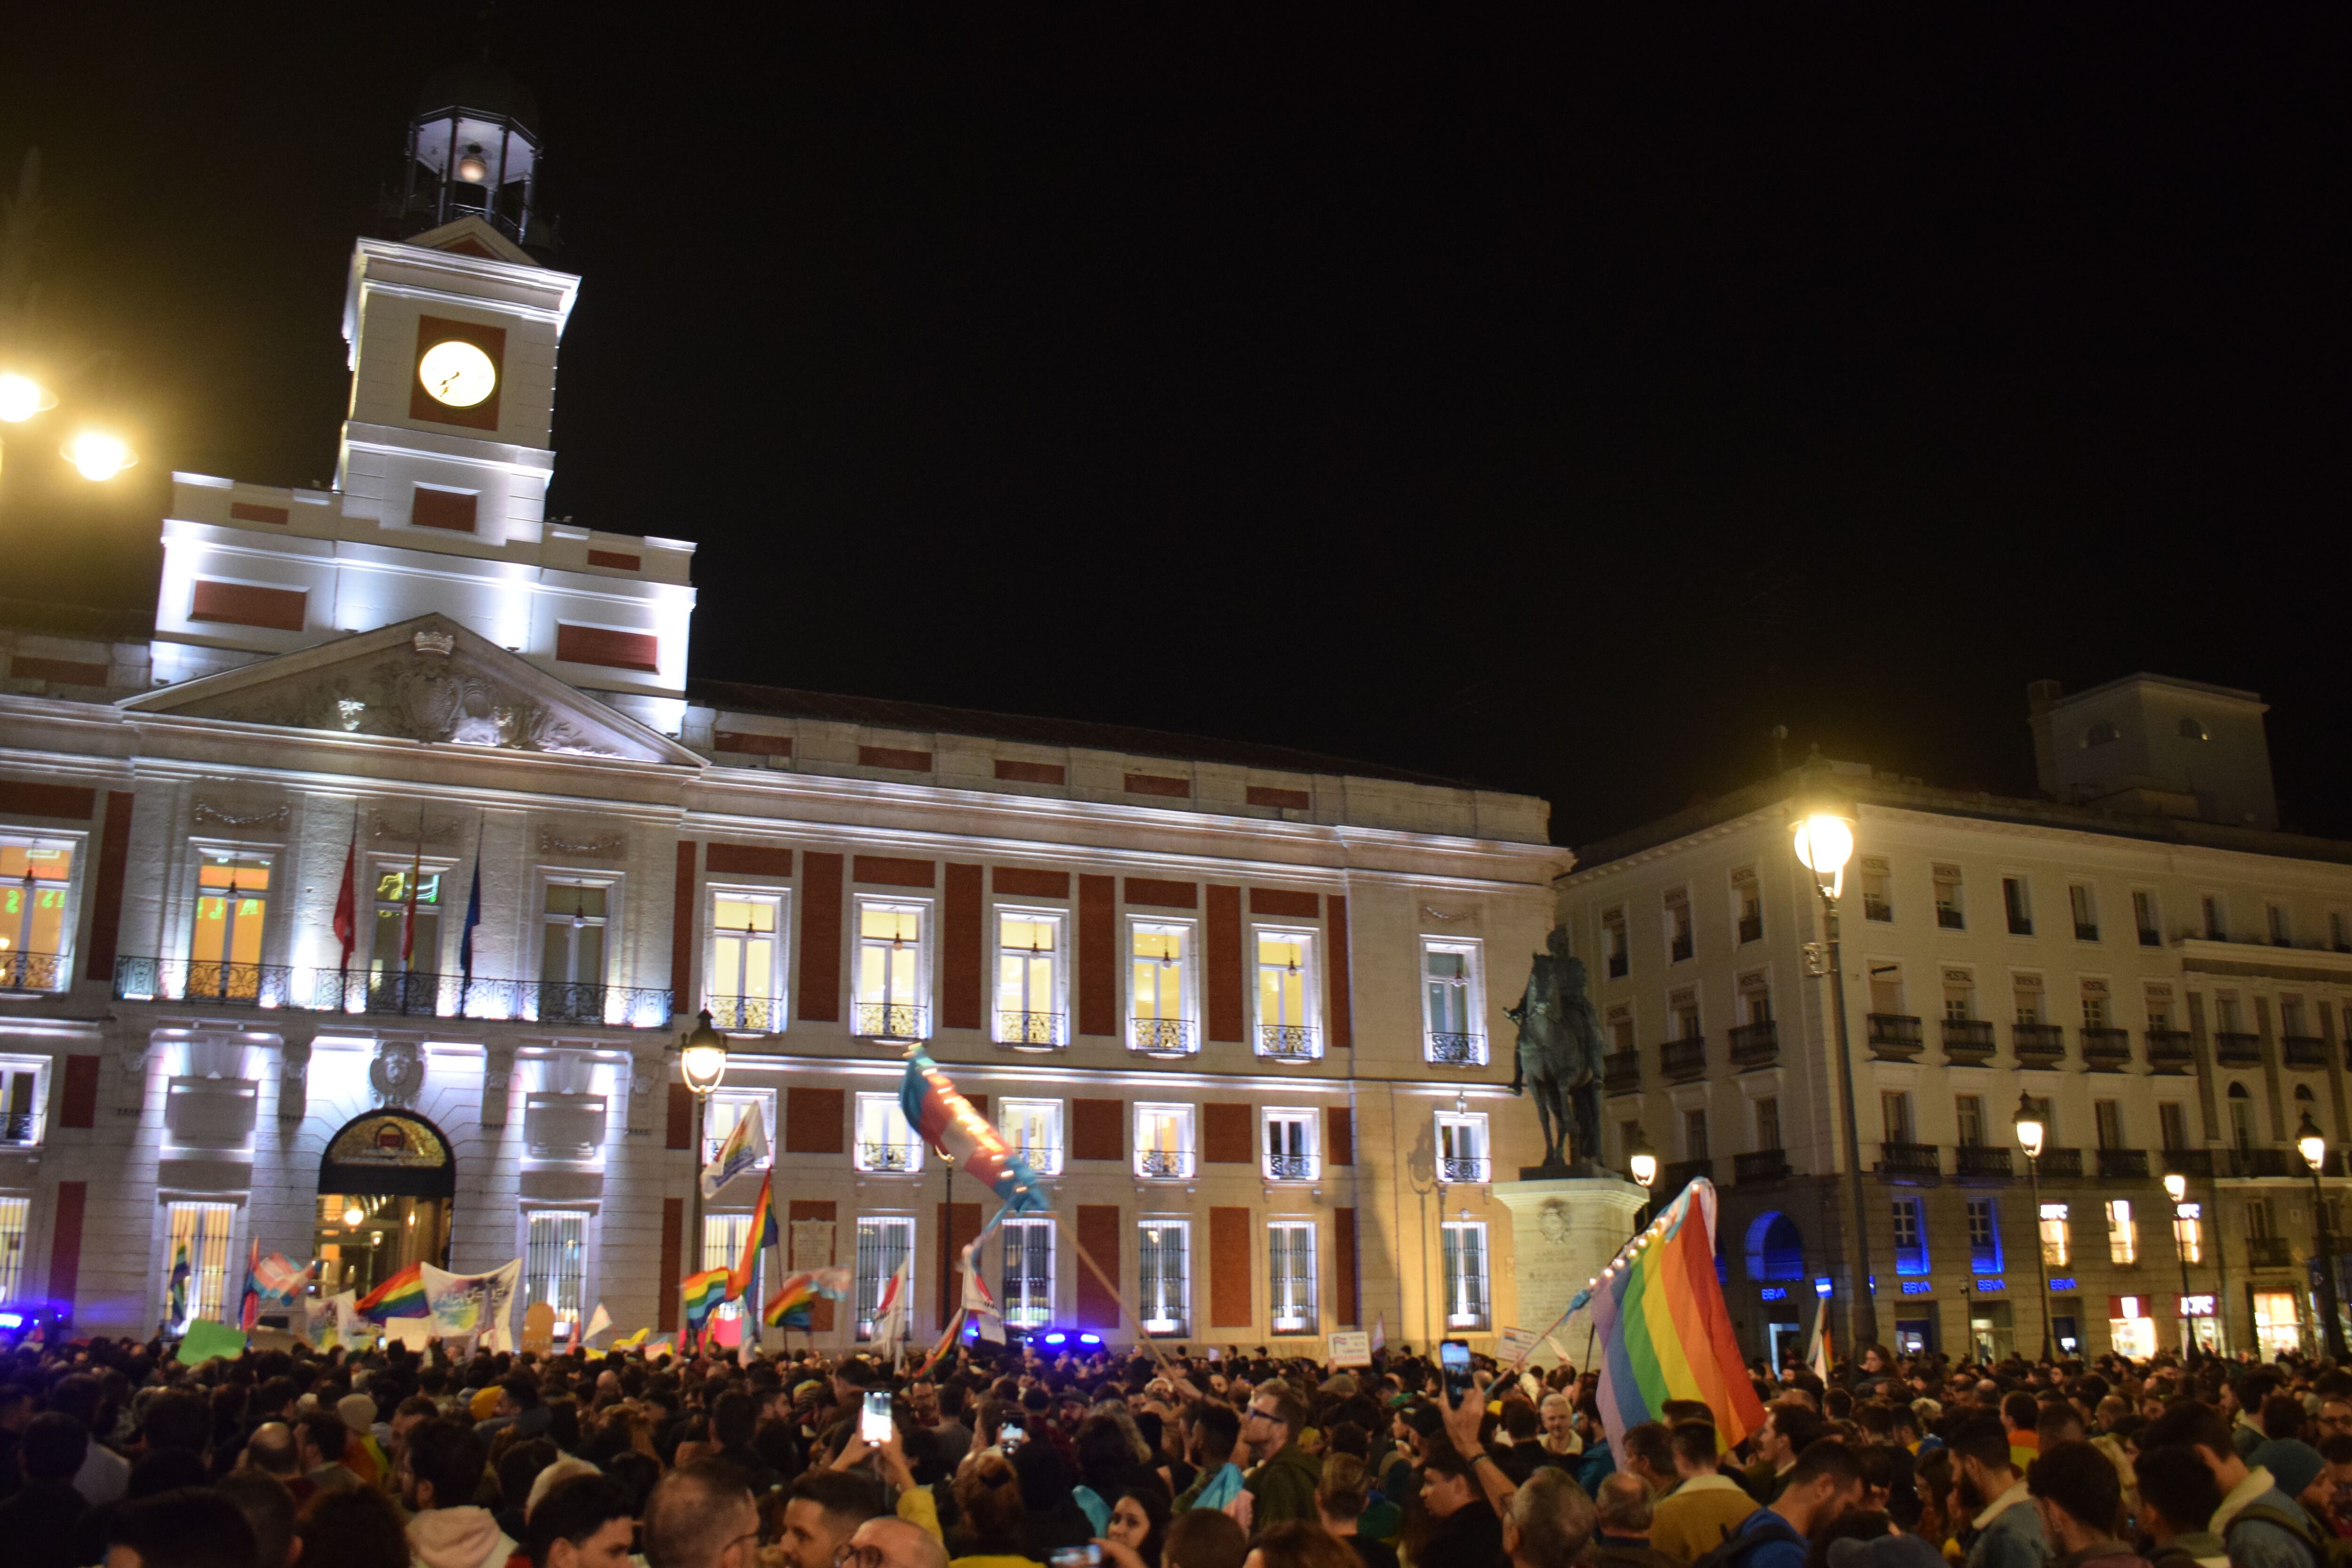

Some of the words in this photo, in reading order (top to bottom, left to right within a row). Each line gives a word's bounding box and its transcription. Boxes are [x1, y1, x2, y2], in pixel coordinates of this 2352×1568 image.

[1740, 973, 1764, 987] HOSTAL
[1945, 970, 1971, 981] HOSTAL
[2082, 980, 2107, 992] HOSTAL
[1902, 1280, 1932, 1295] BBVA
[1977, 1278, 2006, 1292] BBVA
[2049, 1277, 2076, 1291] BBVA
[1761, 1287, 1787, 1301] BBVA
